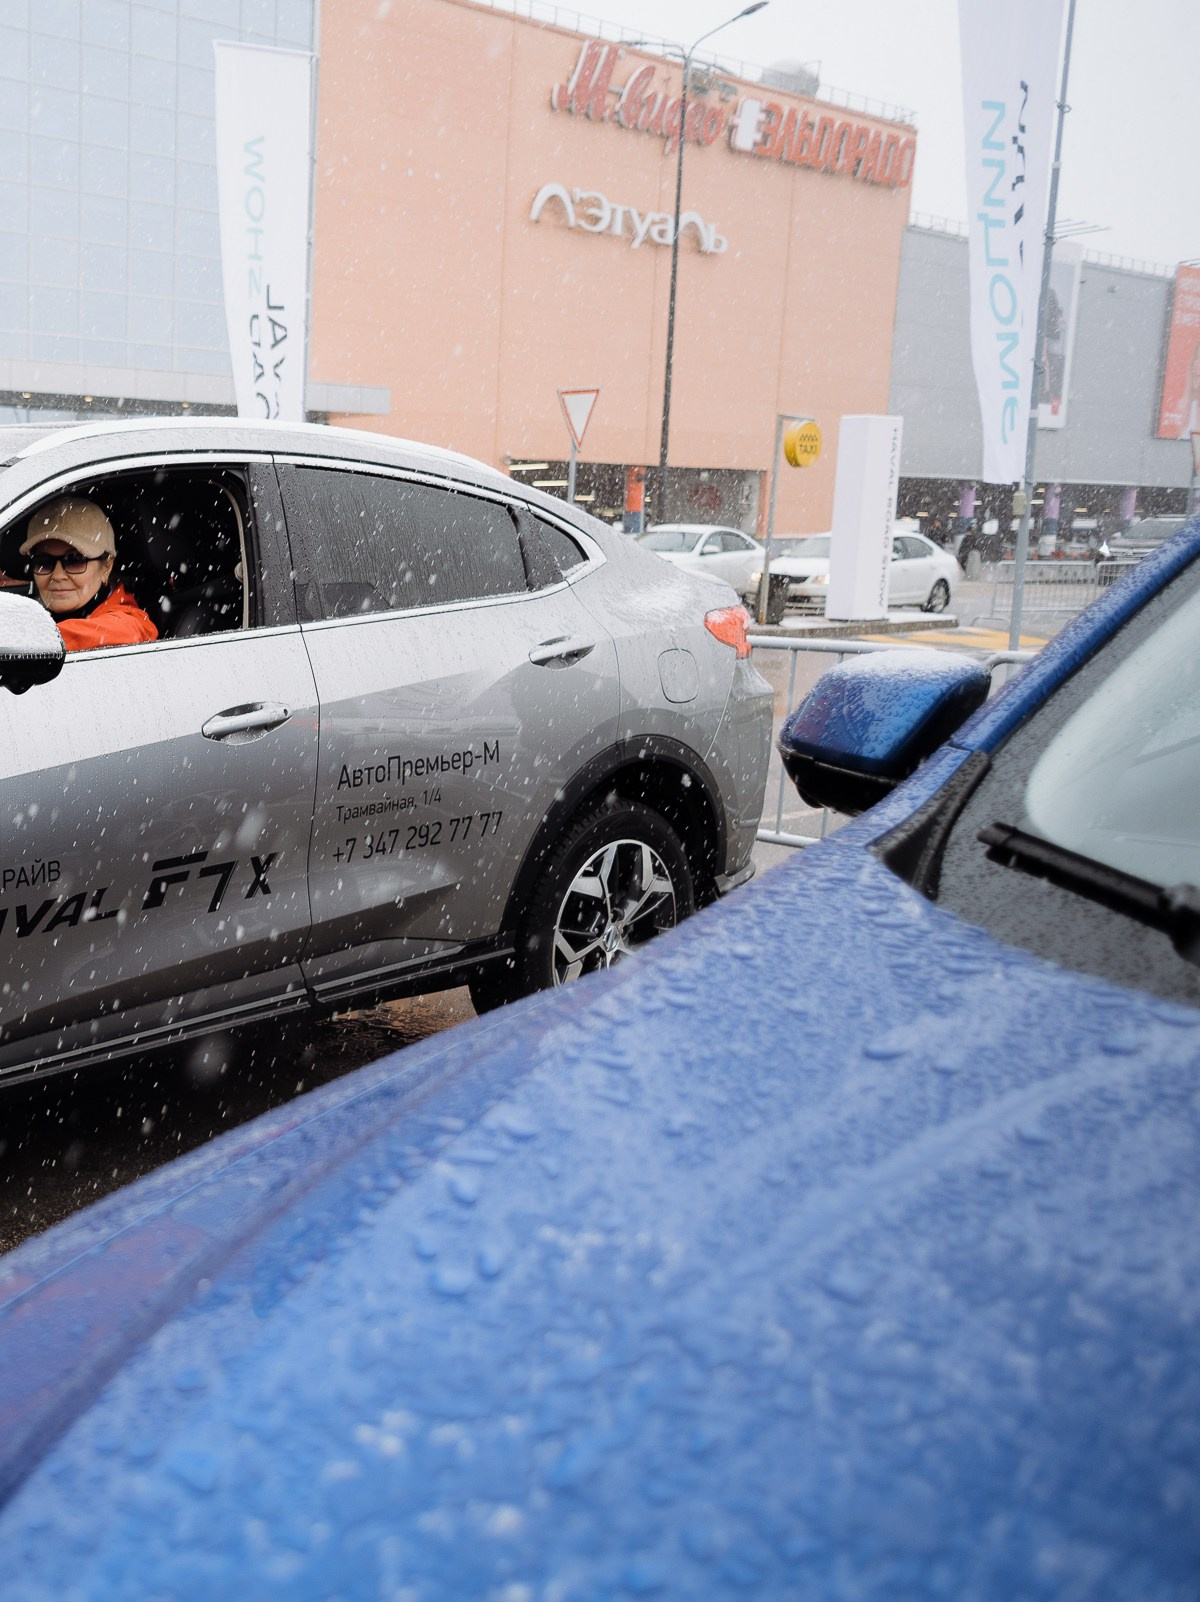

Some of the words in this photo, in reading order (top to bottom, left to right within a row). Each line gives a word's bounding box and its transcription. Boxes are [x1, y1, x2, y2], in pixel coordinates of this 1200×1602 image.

[754, 102, 917, 188] ЭЛЬДОРАДО
[337, 739, 500, 791] АвтоПремьер-М
[336, 796, 417, 825] Трамвайная,
[422, 787, 442, 806] 1/4
[332, 837, 357, 863] +7
[362, 828, 400, 860] 347
[405, 820, 443, 851] 292
[450, 815, 473, 842] 77
[479, 810, 502, 837] 77
